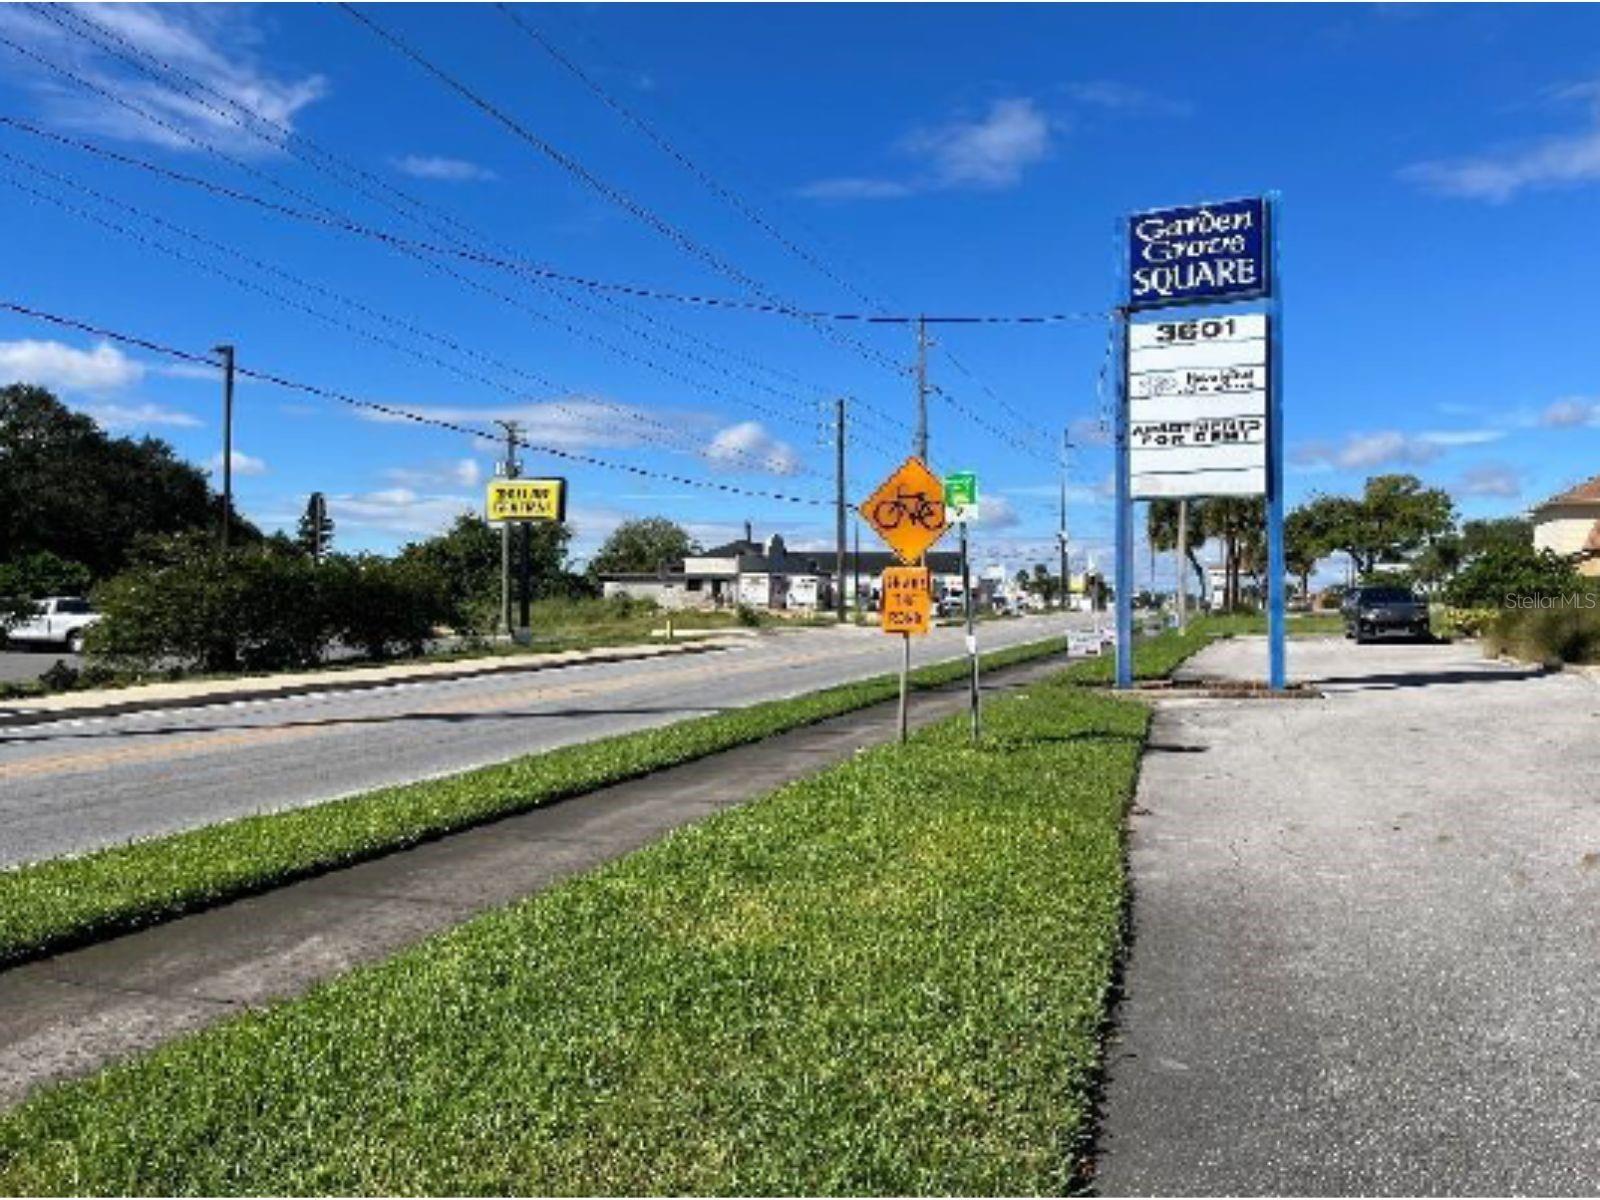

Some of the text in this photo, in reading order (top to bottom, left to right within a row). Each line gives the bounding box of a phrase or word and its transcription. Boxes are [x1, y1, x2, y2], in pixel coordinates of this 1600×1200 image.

[1135, 209, 1253, 242] Garden
[1133, 258, 1257, 296] SQUARE
[1156, 318, 1236, 342] 3601
